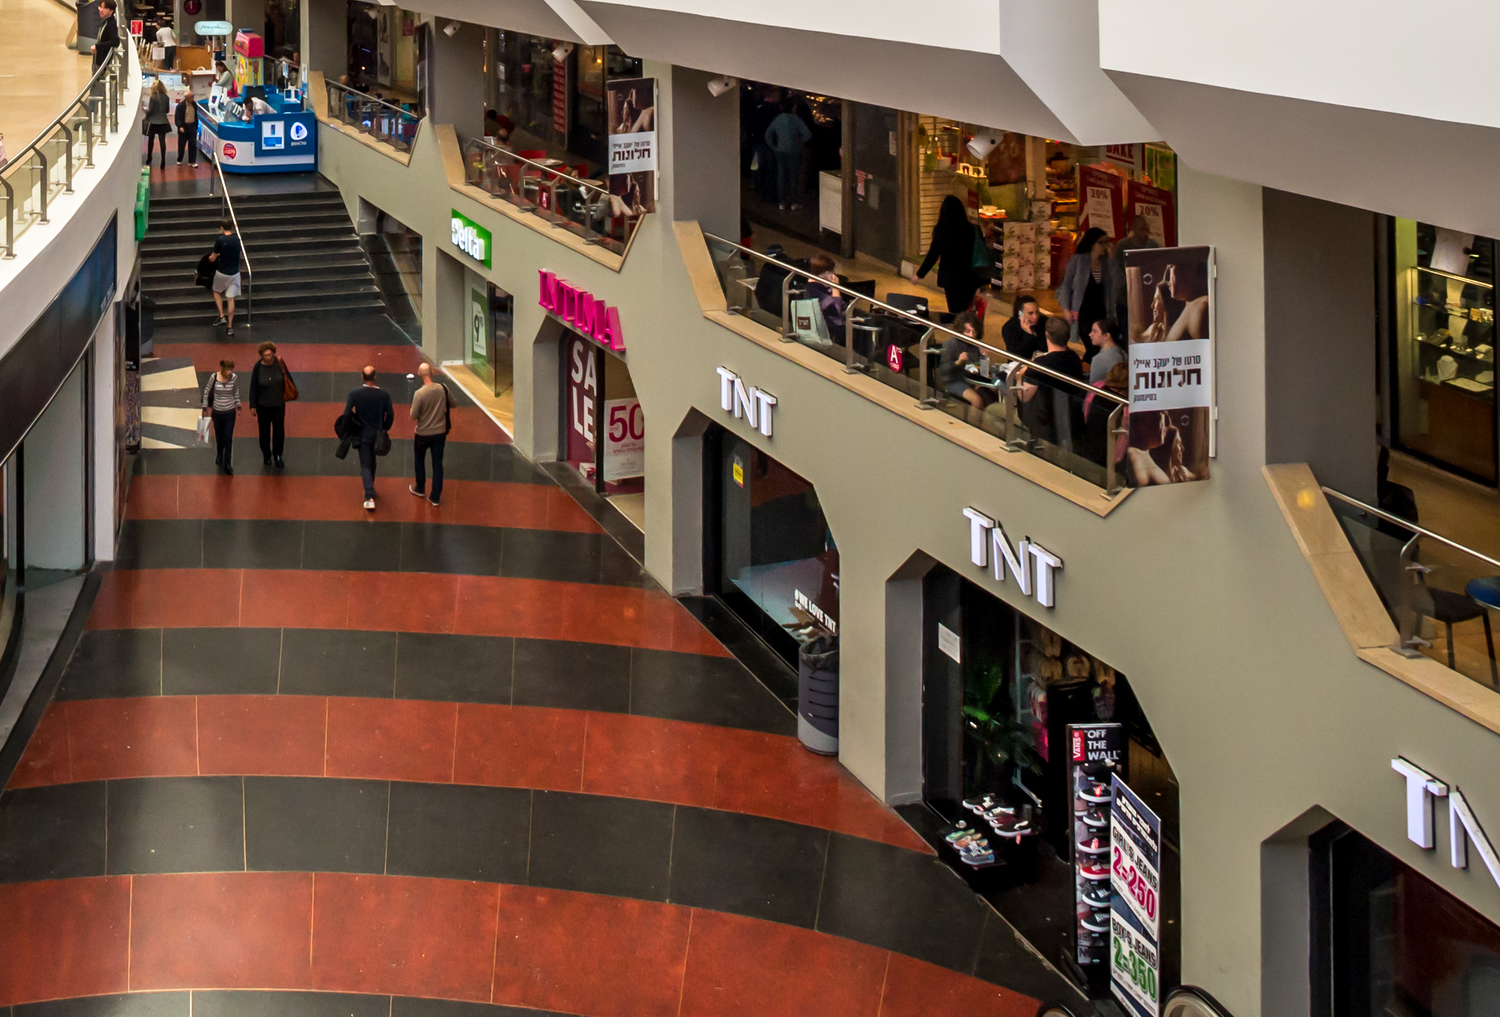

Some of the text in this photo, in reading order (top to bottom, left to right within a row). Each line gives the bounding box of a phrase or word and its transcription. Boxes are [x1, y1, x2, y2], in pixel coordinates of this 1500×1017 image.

[612, 147, 651, 162] חלונות
[1090, 188, 1109, 200] 20%
[1139, 205, 1159, 217] 20%
[451, 217, 485, 261] Delta
[890, 345, 898, 364] A
[1153, 357, 1170, 370] יעקב
[1171, 356, 1183, 367] של
[1184, 354, 1202, 366] סרטו
[1133, 367, 1202, 390] חלונות
[716, 365, 777, 438] TNT
[963, 507, 1064, 608] TNT
[809, 600, 824, 623] LOVE
[824, 613, 837, 634] TNT
[1073, 736, 1082, 760] VANS
[1088, 740, 1107, 750] THE
[1112, 844, 1156, 921] 2=250
[1134, 855, 1158, 890] JEANS
[1133, 937, 1158, 968] JEANS
[1113, 935, 1157, 1002] 2=350
